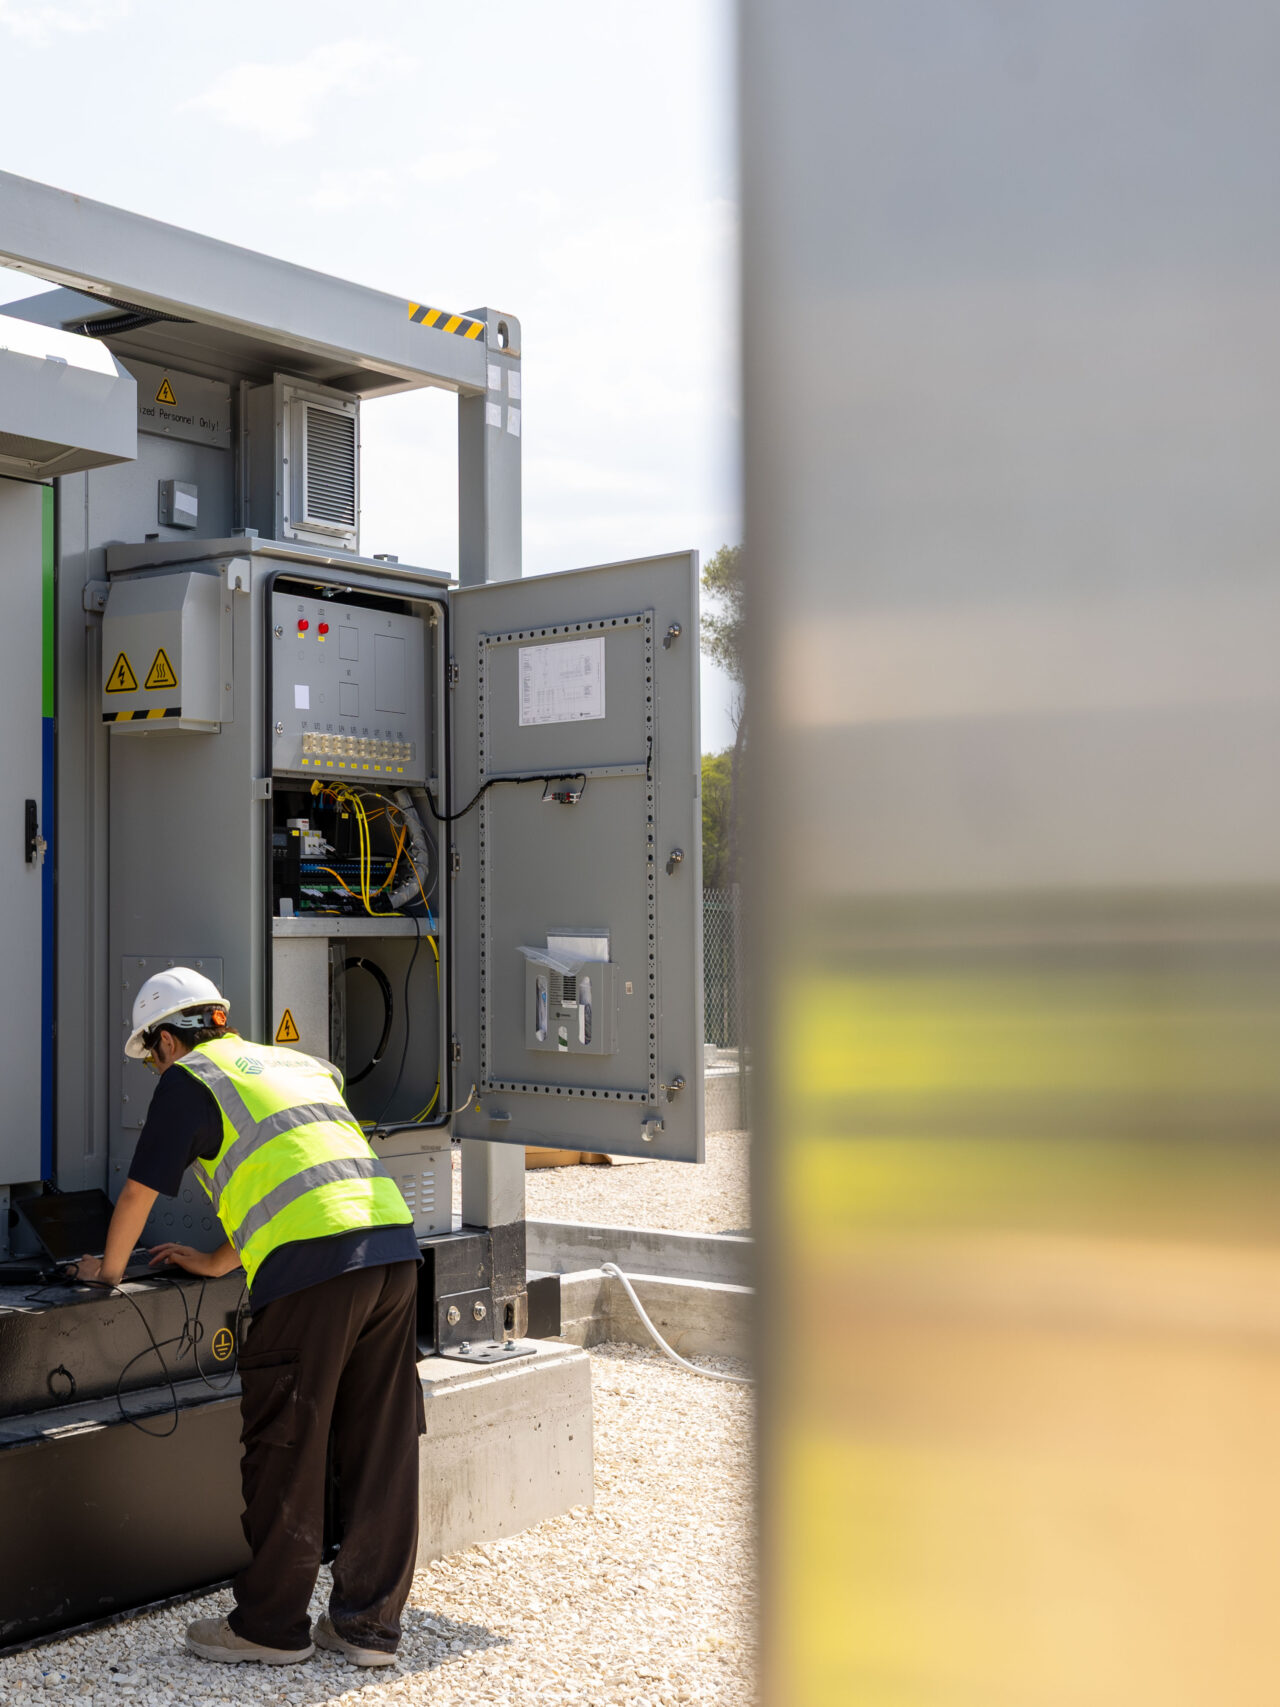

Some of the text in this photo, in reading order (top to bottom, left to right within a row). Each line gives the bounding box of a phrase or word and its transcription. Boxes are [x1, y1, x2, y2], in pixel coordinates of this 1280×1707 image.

[139, 407, 219, 432] ized Personnel Only!
